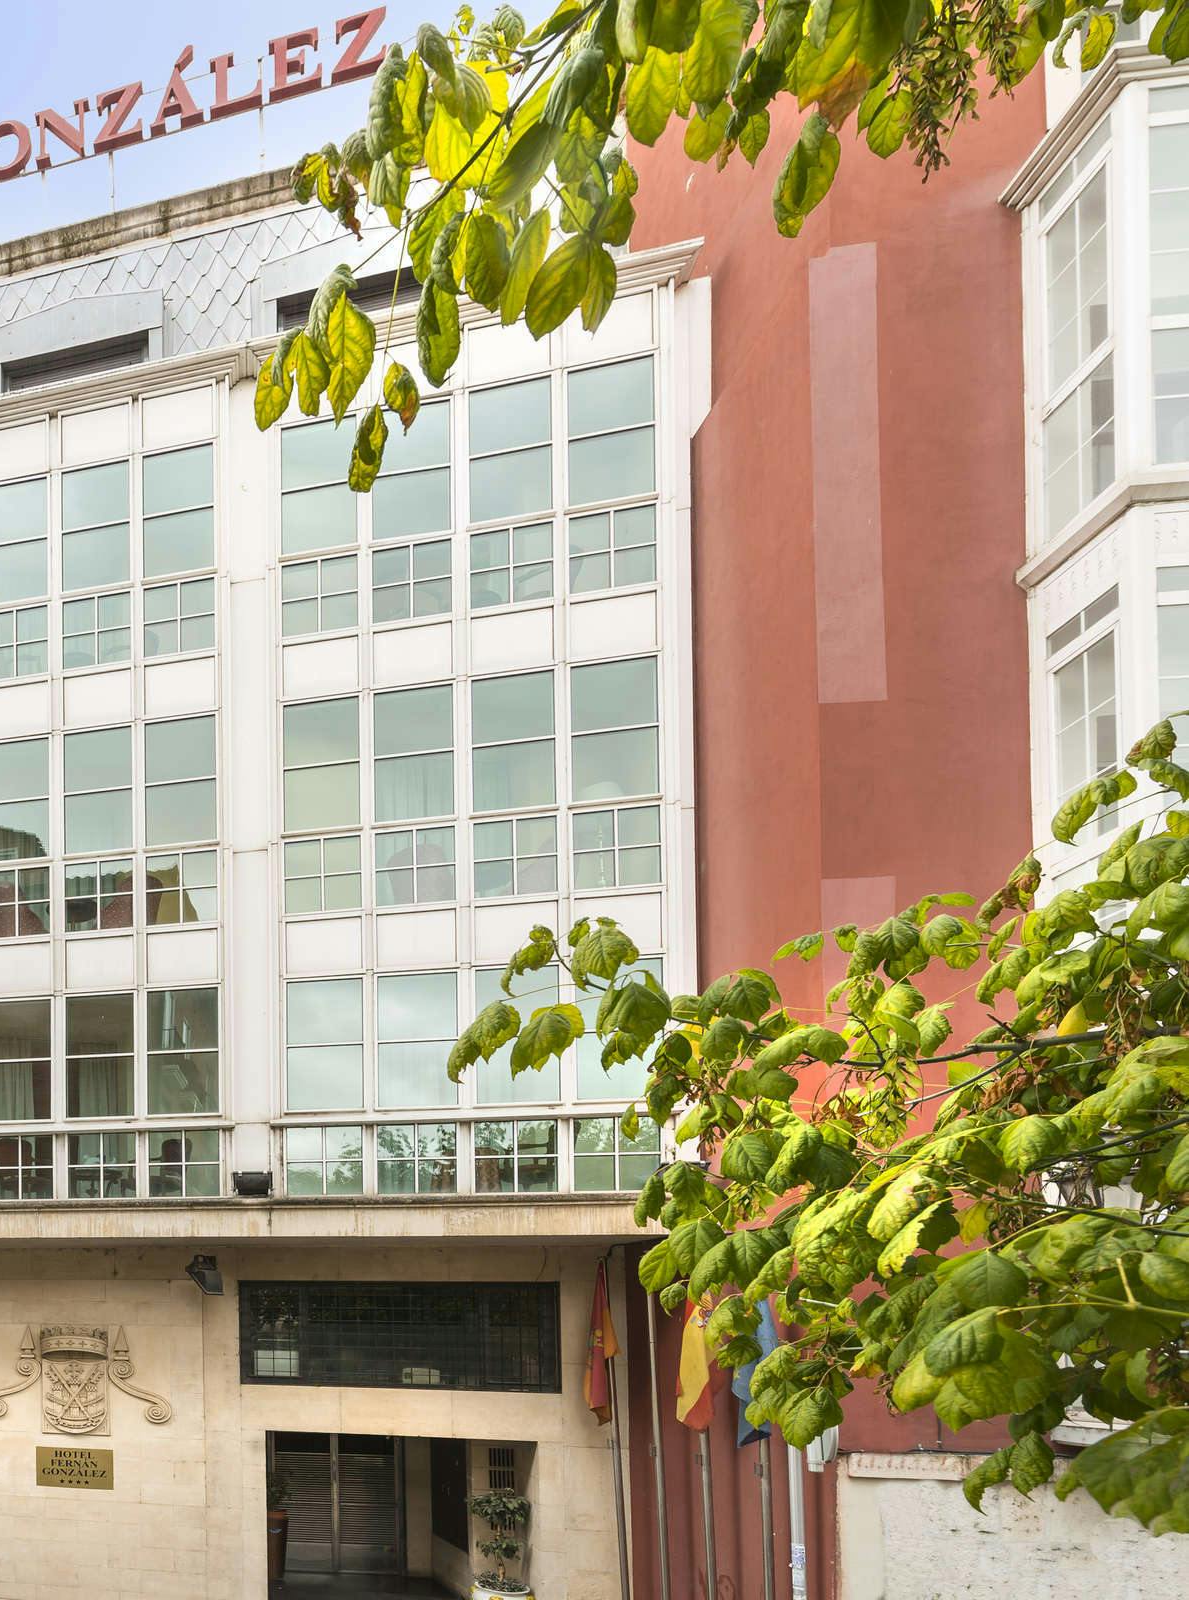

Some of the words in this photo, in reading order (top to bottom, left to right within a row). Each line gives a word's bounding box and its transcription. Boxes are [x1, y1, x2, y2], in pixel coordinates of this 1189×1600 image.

[54, 1450, 95, 1460] HOTEL
[50, 1458, 98, 1469] FERNÁN
[42, 1467, 107, 1478] GONZÁLEZ
